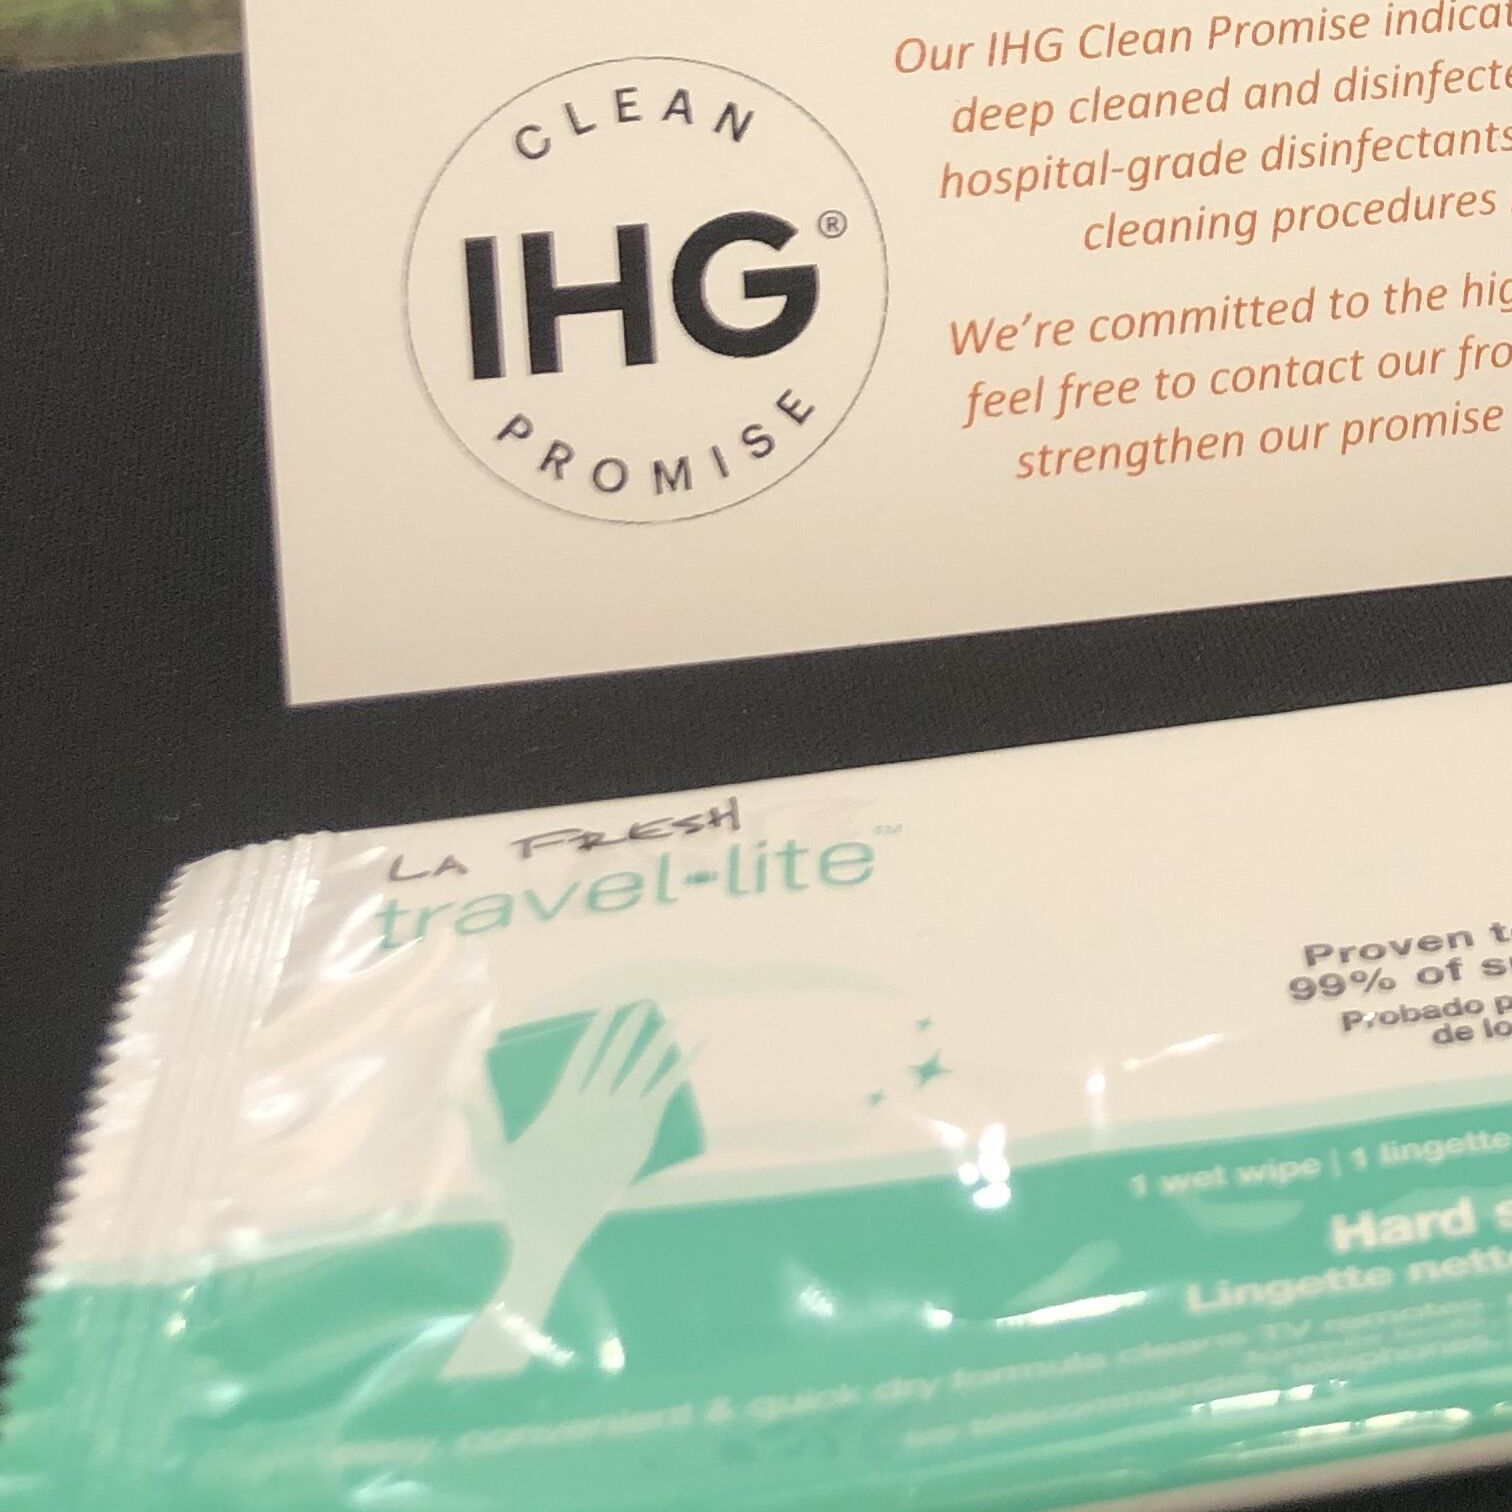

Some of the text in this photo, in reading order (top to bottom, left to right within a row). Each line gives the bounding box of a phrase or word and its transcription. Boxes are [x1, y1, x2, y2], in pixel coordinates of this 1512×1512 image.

[894, 37, 975, 74] Our
[987, 26, 1065, 68] IHG
[1078, 21, 1193, 60] Clean
[1207, 6, 1371, 51] Promise
[513, 85, 756, 161] CLEAN
[939, 138, 1248, 202] hospital-grade
[1083, 204, 1258, 251] cleaning
[1271, 185, 1497, 244] procedures
[1089, 285, 1316, 343] committed
[1328, 287, 1370, 321] to
[1383, 276, 1448, 316] the
[497, 388, 816, 495] PROMISE
[388, 796, 741, 881] LA FRESH
[1288, 966, 1398, 1002] 99%
[1416, 956, 1464, 985] of
[1303, 927, 1476, 968] Proven
[1431, 1023, 1475, 1046] de
[1236, 1157, 1321, 1188] wipe
[1329, 1195, 1477, 1255] Hard
[1185, 1264, 1395, 1315] Lingette
